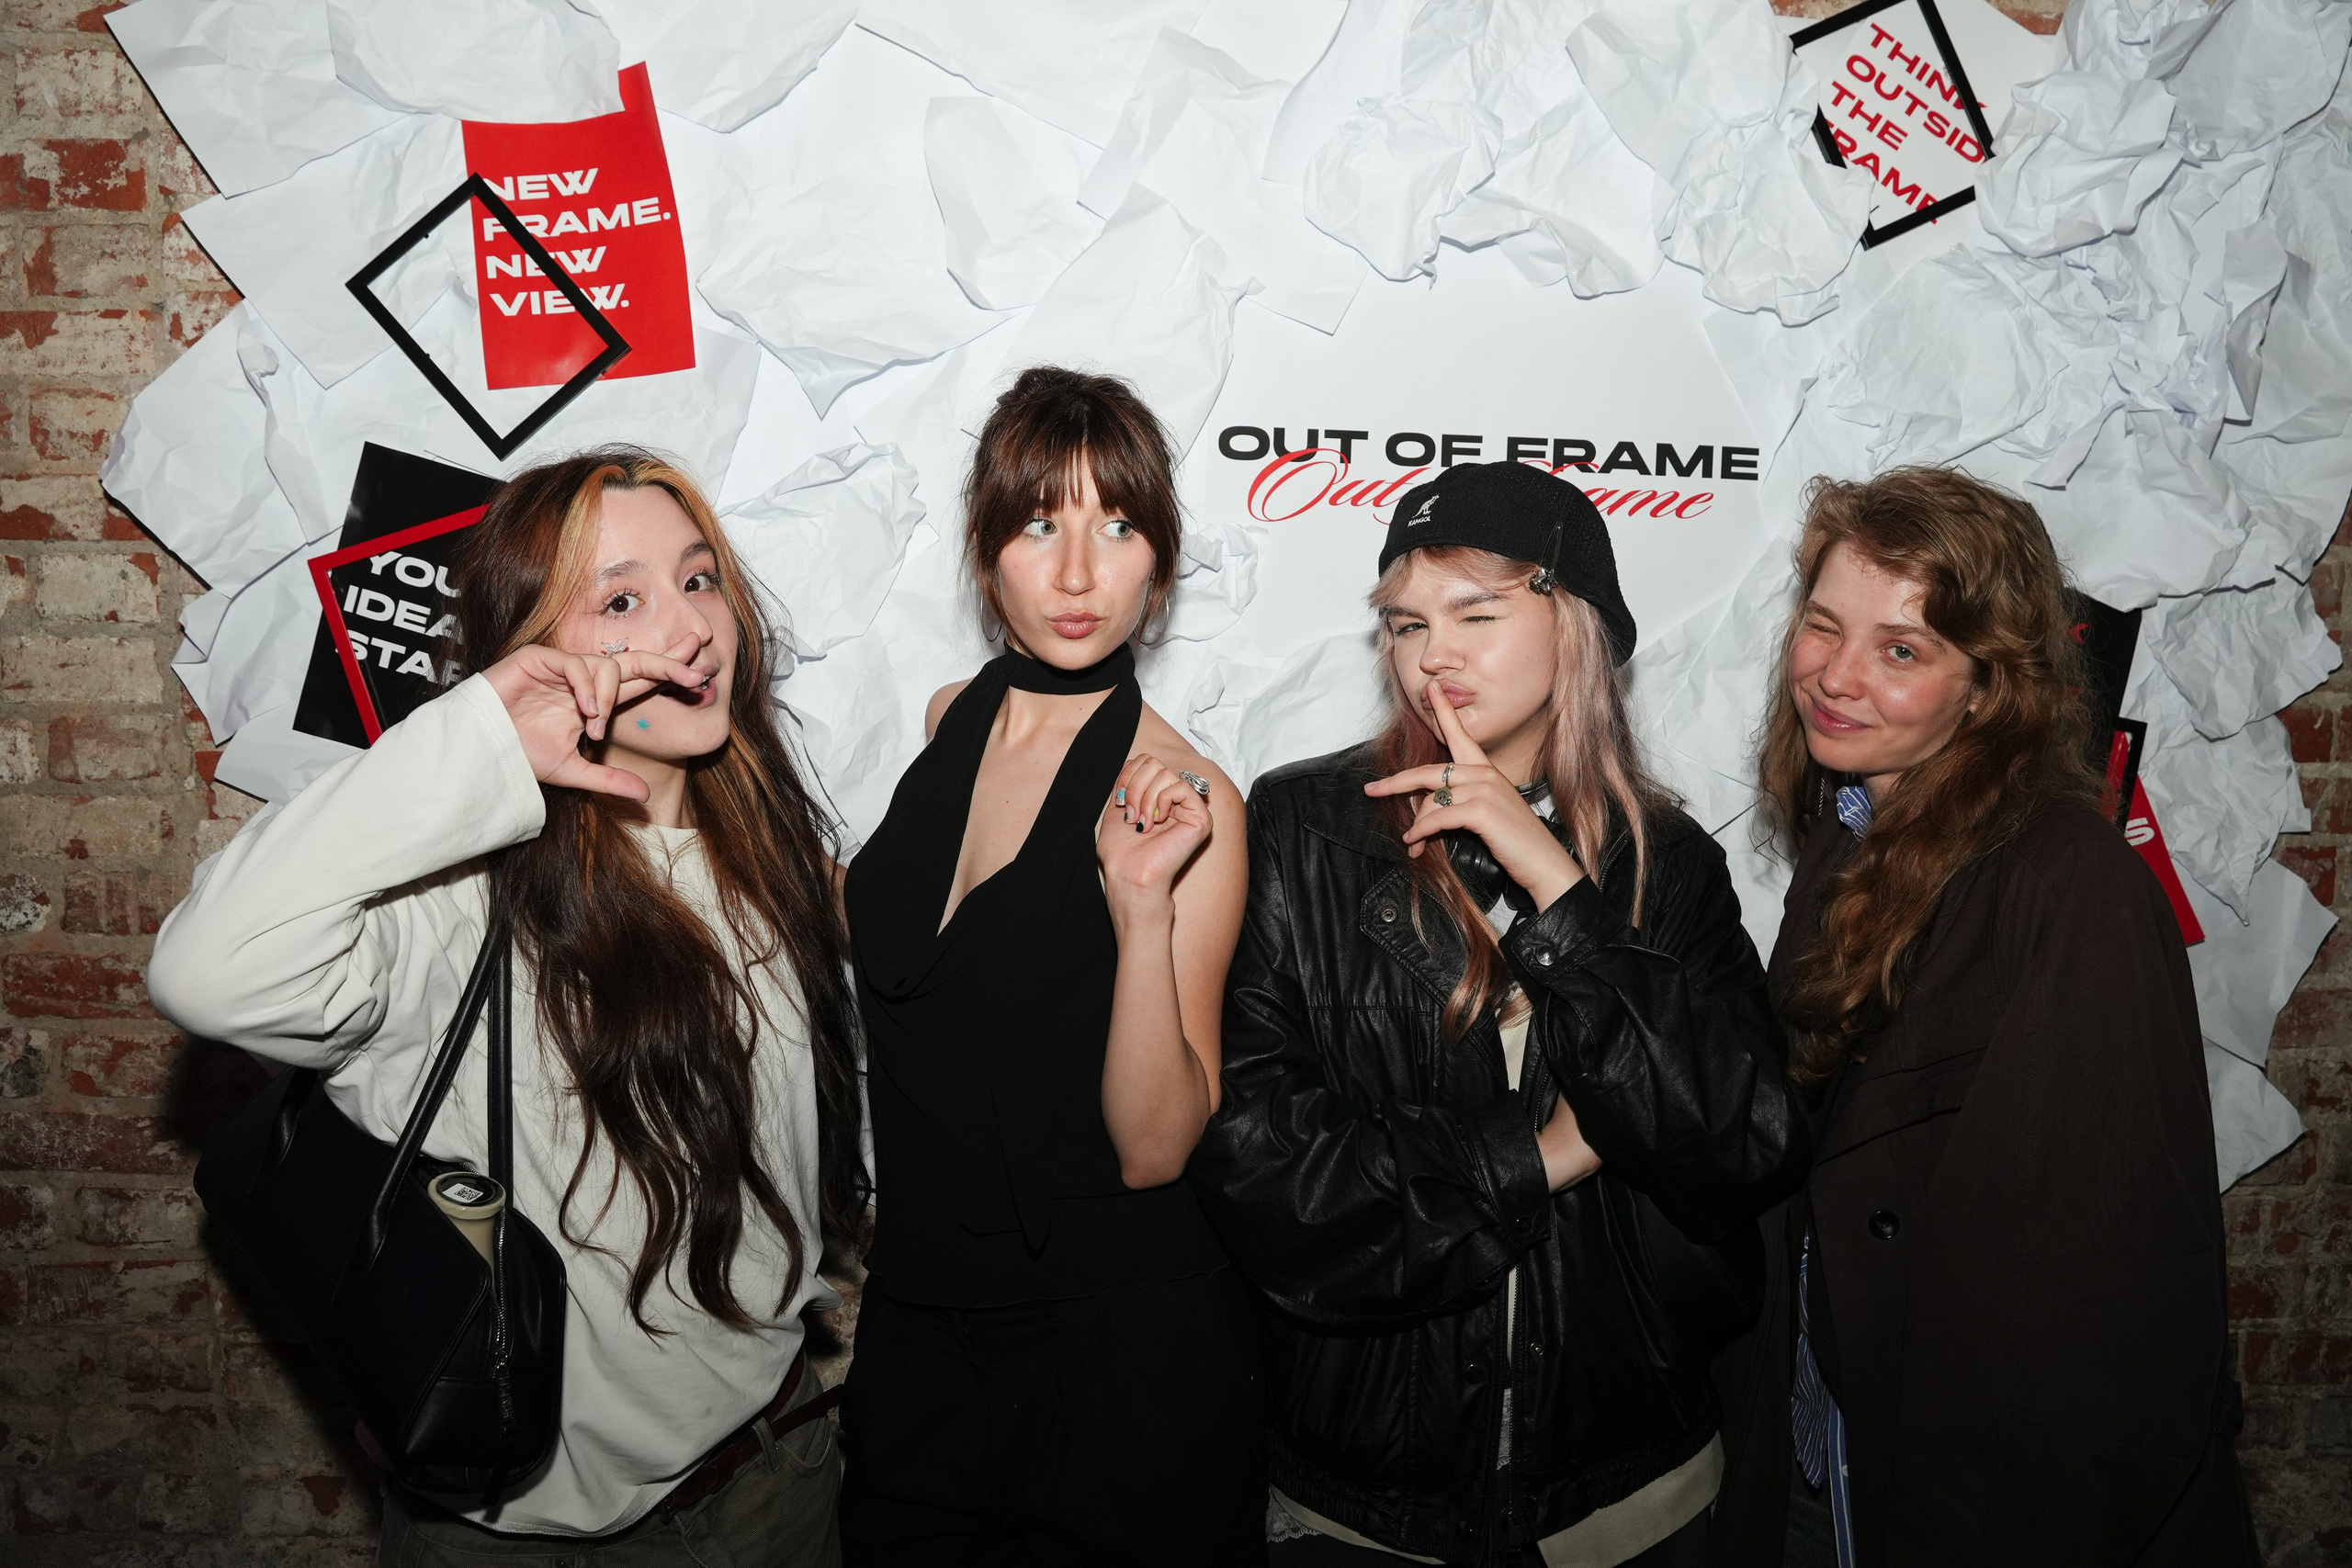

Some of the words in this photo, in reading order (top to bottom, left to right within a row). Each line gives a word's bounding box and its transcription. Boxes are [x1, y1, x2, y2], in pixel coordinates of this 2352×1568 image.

[1831, 80, 1908, 151] THE
[1846, 54, 1988, 164] OUTSID
[482, 167, 599, 201] NEW
[482, 197, 672, 242] FRAME.
[489, 283, 630, 317] VIEW.
[1218, 425, 1368, 464] OUT
[1385, 432, 1483, 468] OF
[1506, 436, 1759, 480] FRAME
[1247, 447, 1432, 523] Out
[1408, 515, 1431, 527] KANGOL
